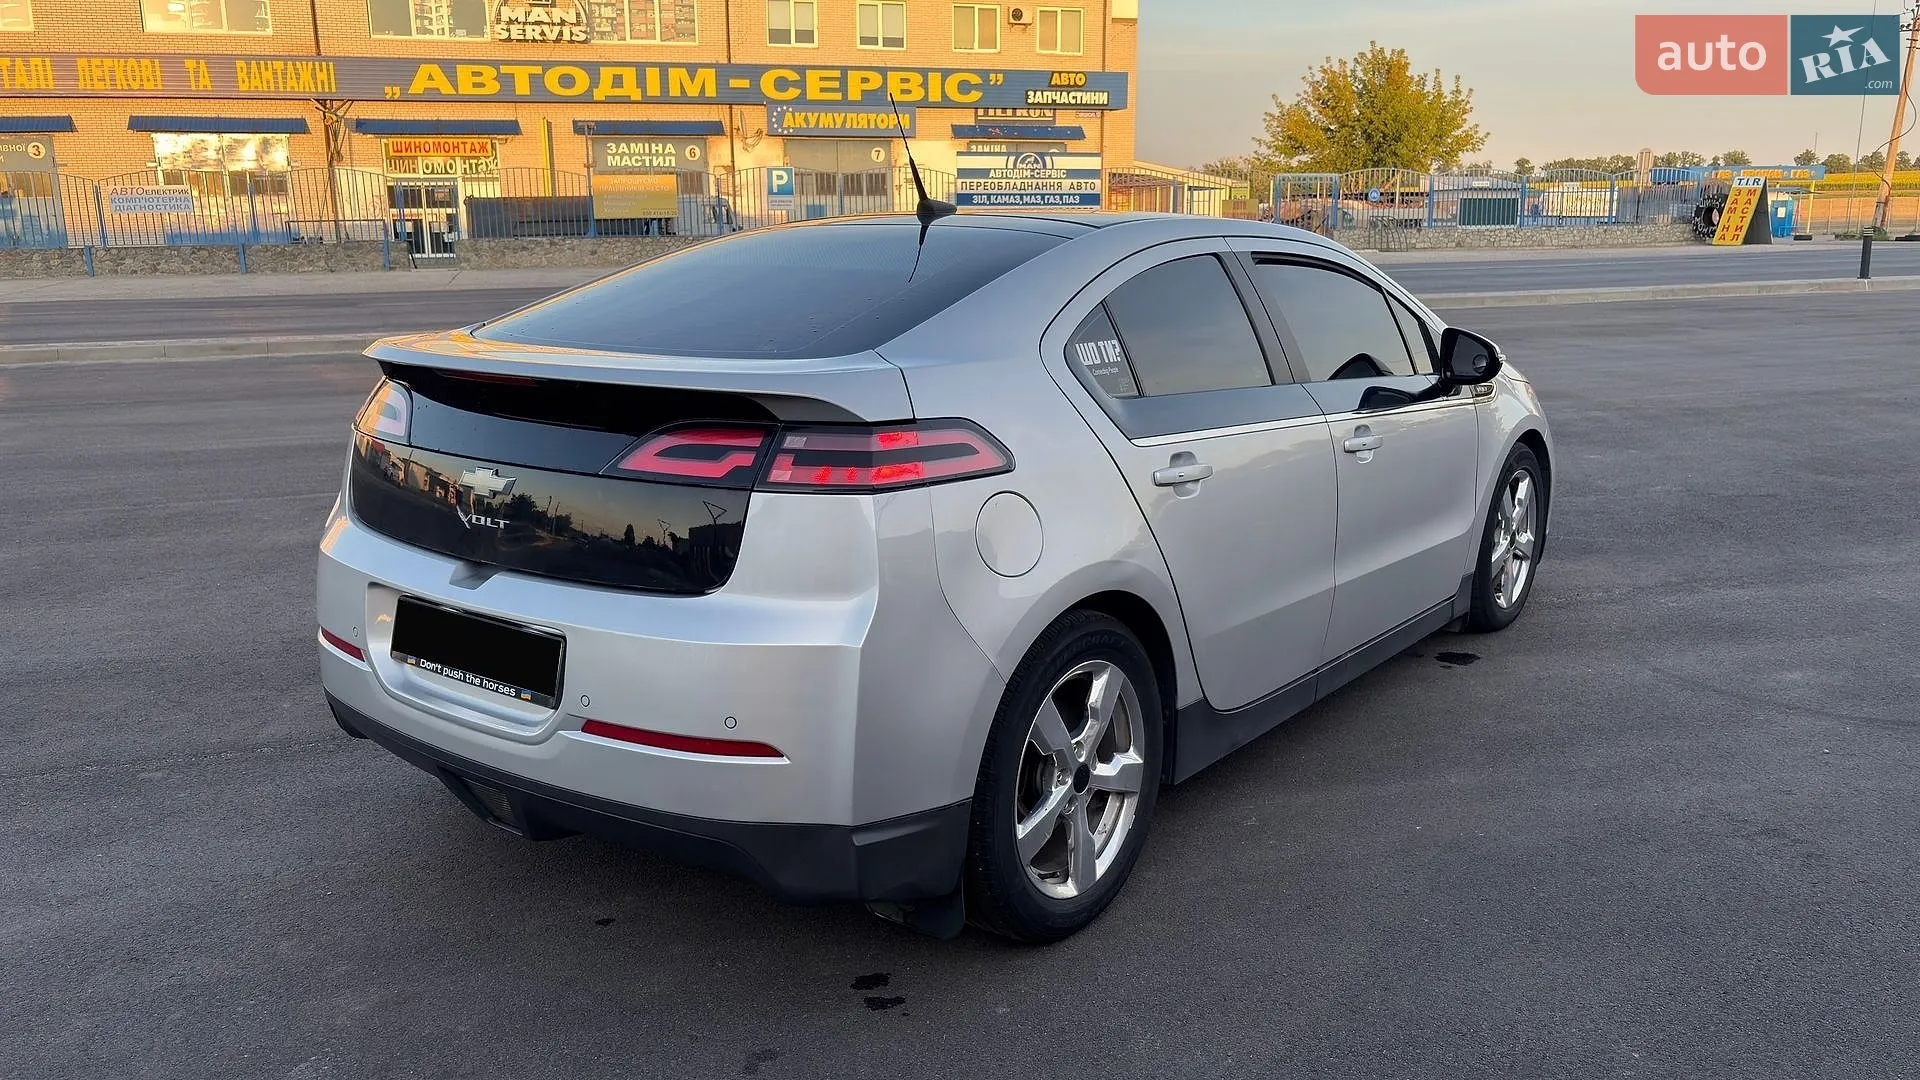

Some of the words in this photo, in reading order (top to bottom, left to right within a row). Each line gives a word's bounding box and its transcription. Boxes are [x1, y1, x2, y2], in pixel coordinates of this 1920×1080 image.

[501, 6, 577, 23] MAN
[495, 25, 587, 41] SERVIS
[185, 60, 212, 91] ТА
[235, 61, 337, 92] ВАНТАЖНІ
[1050, 72, 1087, 86] АВТО
[1027, 90, 1108, 105] ЗАПЧАСТИНИ
[783, 111, 910, 129] АКУМУЛЯТОРИ
[31, 145, 42, 157] 3
[392, 141, 489, 154] ШИНОМОНТАЖ
[606, 143, 676, 154] ЗАМІНА
[689, 147, 697, 158] 6
[874, 150, 881, 160] 7
[607, 155, 676, 167] МАСТИЛ
[772, 170, 788, 192] P
[989, 169, 1067, 180] АВТОДІМ-СЕРВІС
[960, 181, 1062, 192] ПЕРЕОБЛАДНАННЯ
[1069, 181, 1096, 191] АВТО
[1063, 195, 1080, 204] ПАЗ
[114, 204, 191, 212] ДІАГНОСТИКА
[1718, 189, 1742, 241] ЗАМІНА
[1730, 188, 1757, 241] МАСТИЛ
[1075, 342, 1101, 366] ШО
[456, 505, 511, 529] VOLT
[420, 658, 442, 673] Don't
[443, 666, 464, 681] push
[466, 672, 481, 686] the
[482, 679, 516, 697] horses
